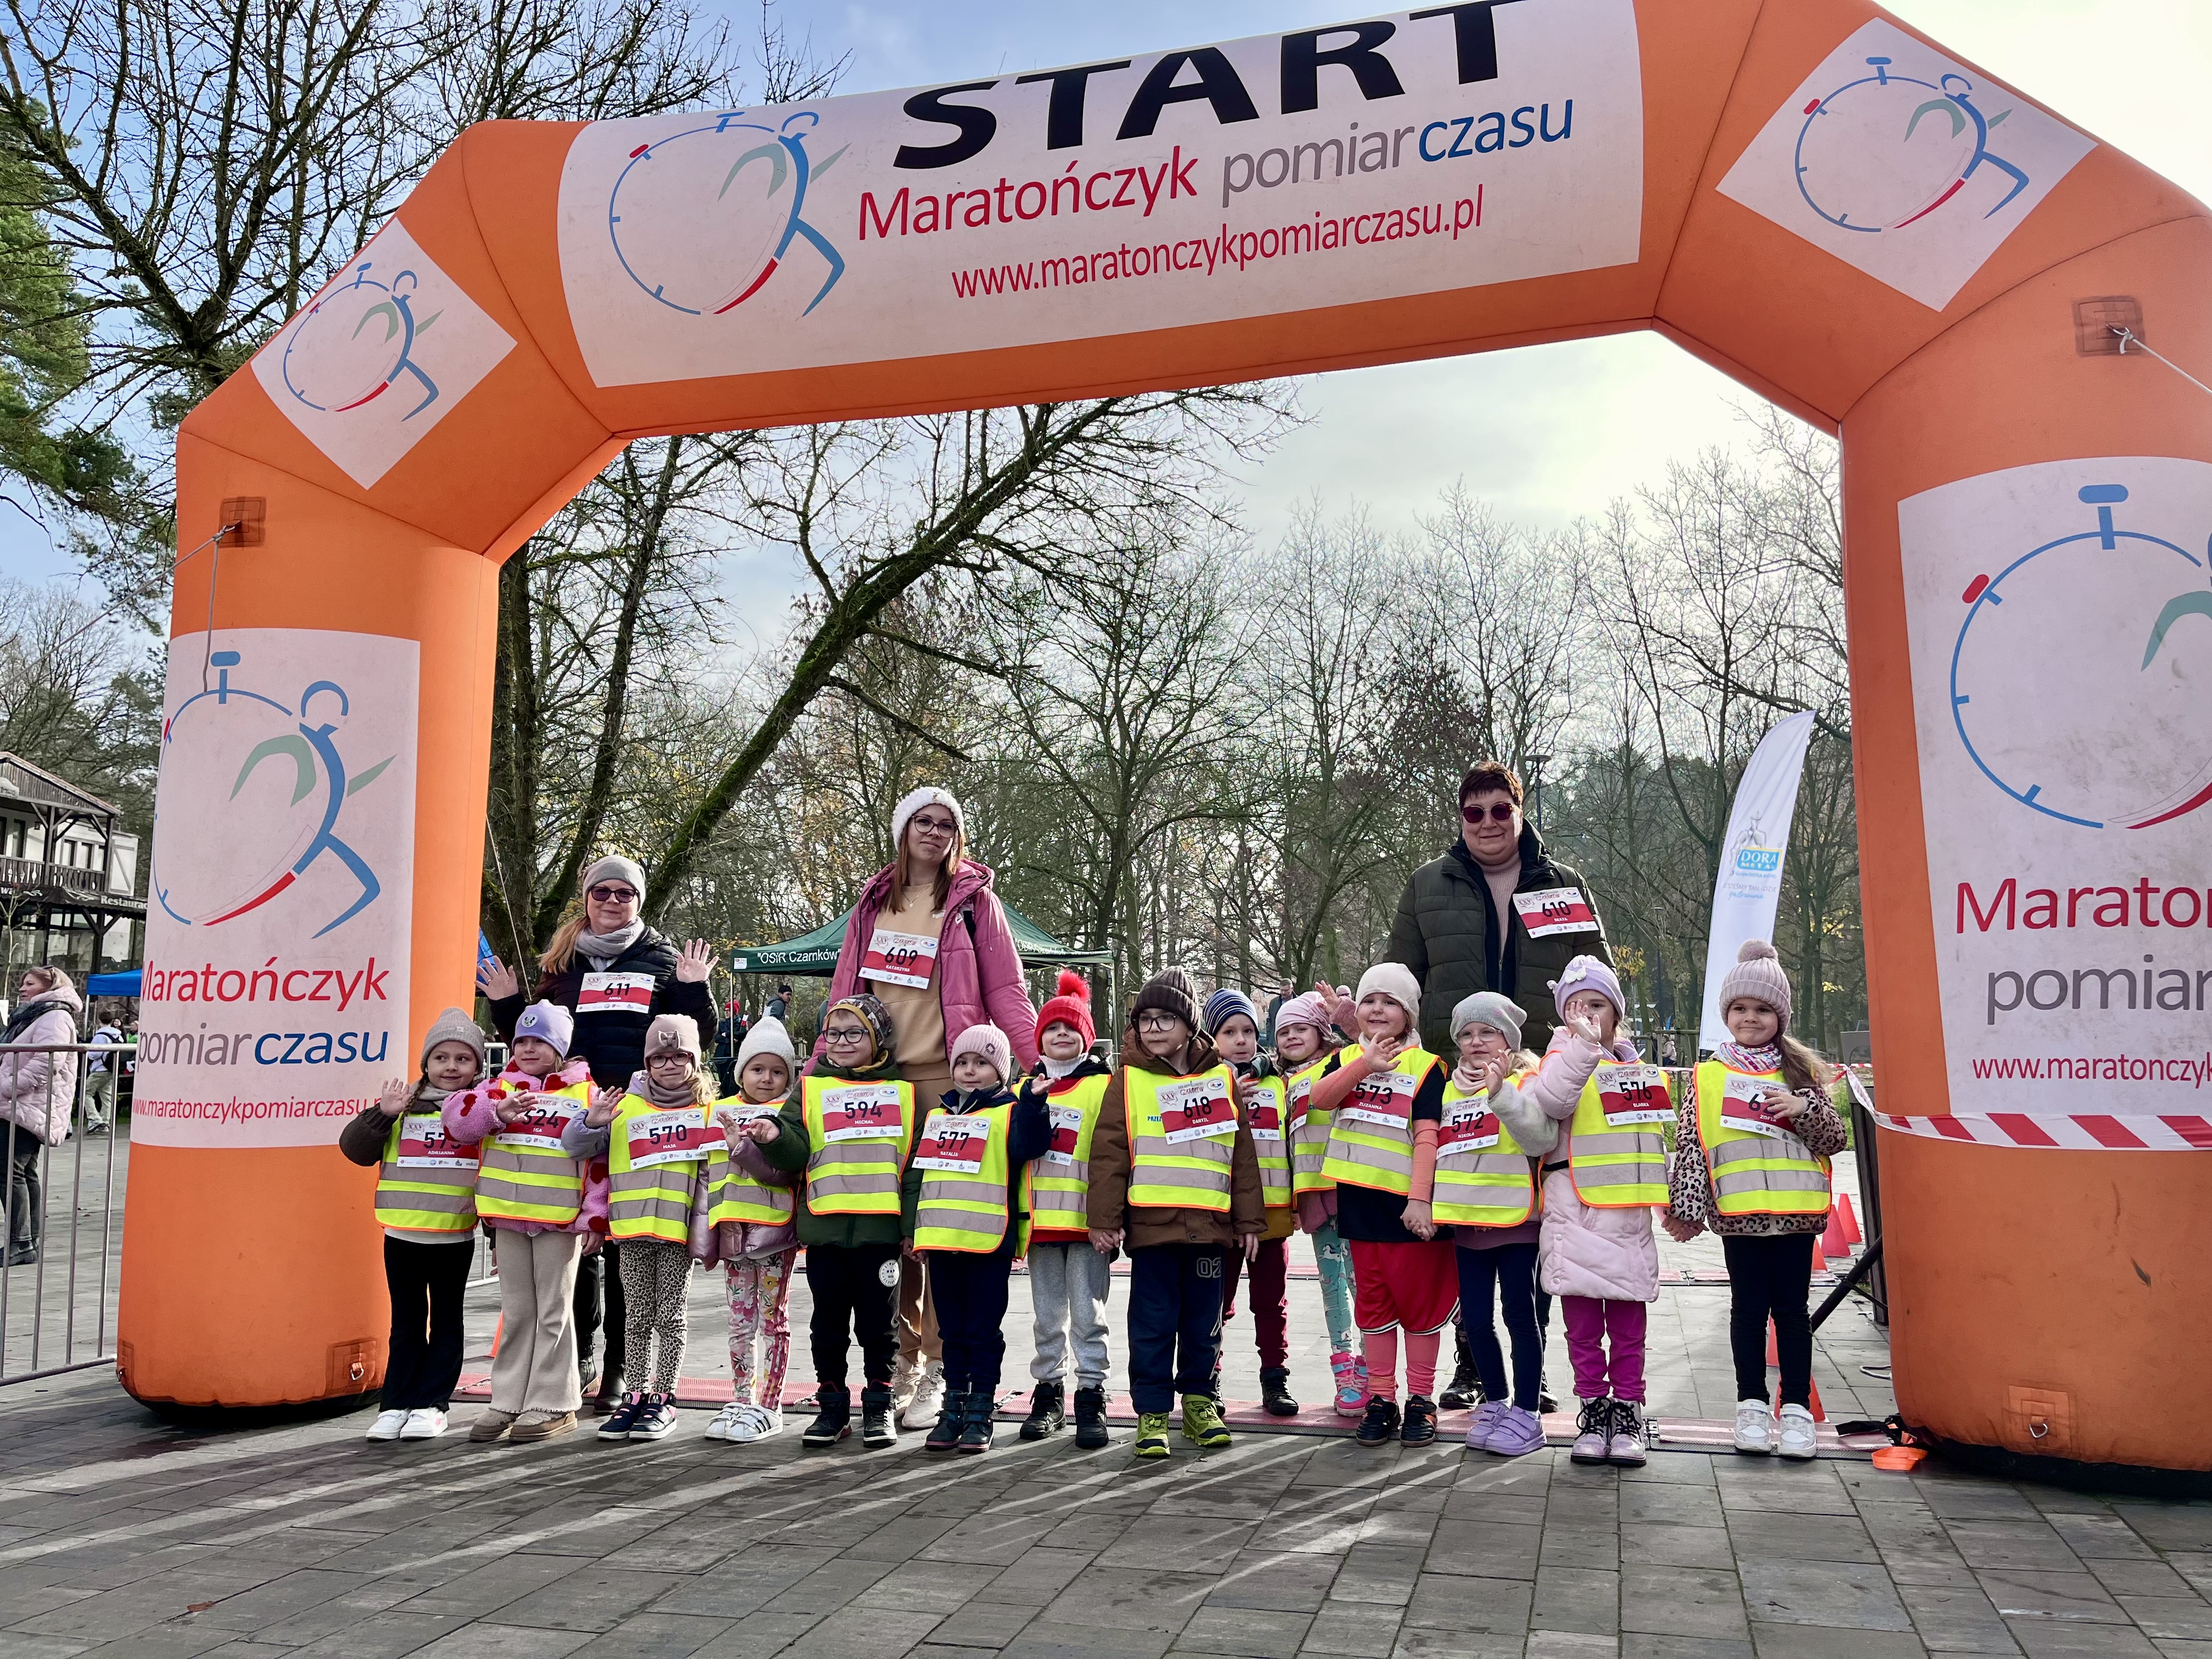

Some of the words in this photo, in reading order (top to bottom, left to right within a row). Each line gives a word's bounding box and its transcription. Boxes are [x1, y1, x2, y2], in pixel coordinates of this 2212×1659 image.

[893, 0, 1526, 170] START
[859, 146, 1198, 240] Maratończyk
[952, 184, 1483, 298] www.maratonczykpomiarczasu.pl
[1741, 851, 1776, 864] DORA
[1542, 901, 1571, 917] 610
[1956, 878, 2212, 934] Marato
[885, 947, 918, 966] 609
[142, 957, 390, 1011] Maratończyk
[604, 983, 630, 996] 611
[1355, 1082, 1393, 1105] 573
[1619, 1081, 1652, 1102] 576
[844, 1101, 883, 1120] 594
[1183, 1096, 1212, 1118] 618
[1358, 1102, 1382, 1110] ZUZANNA
[1451, 1111, 1485, 1133] 572
[649, 1124, 687, 1145] 570
[936, 1131, 970, 1150] 577
[1197, 1256, 1222, 1278] 02
